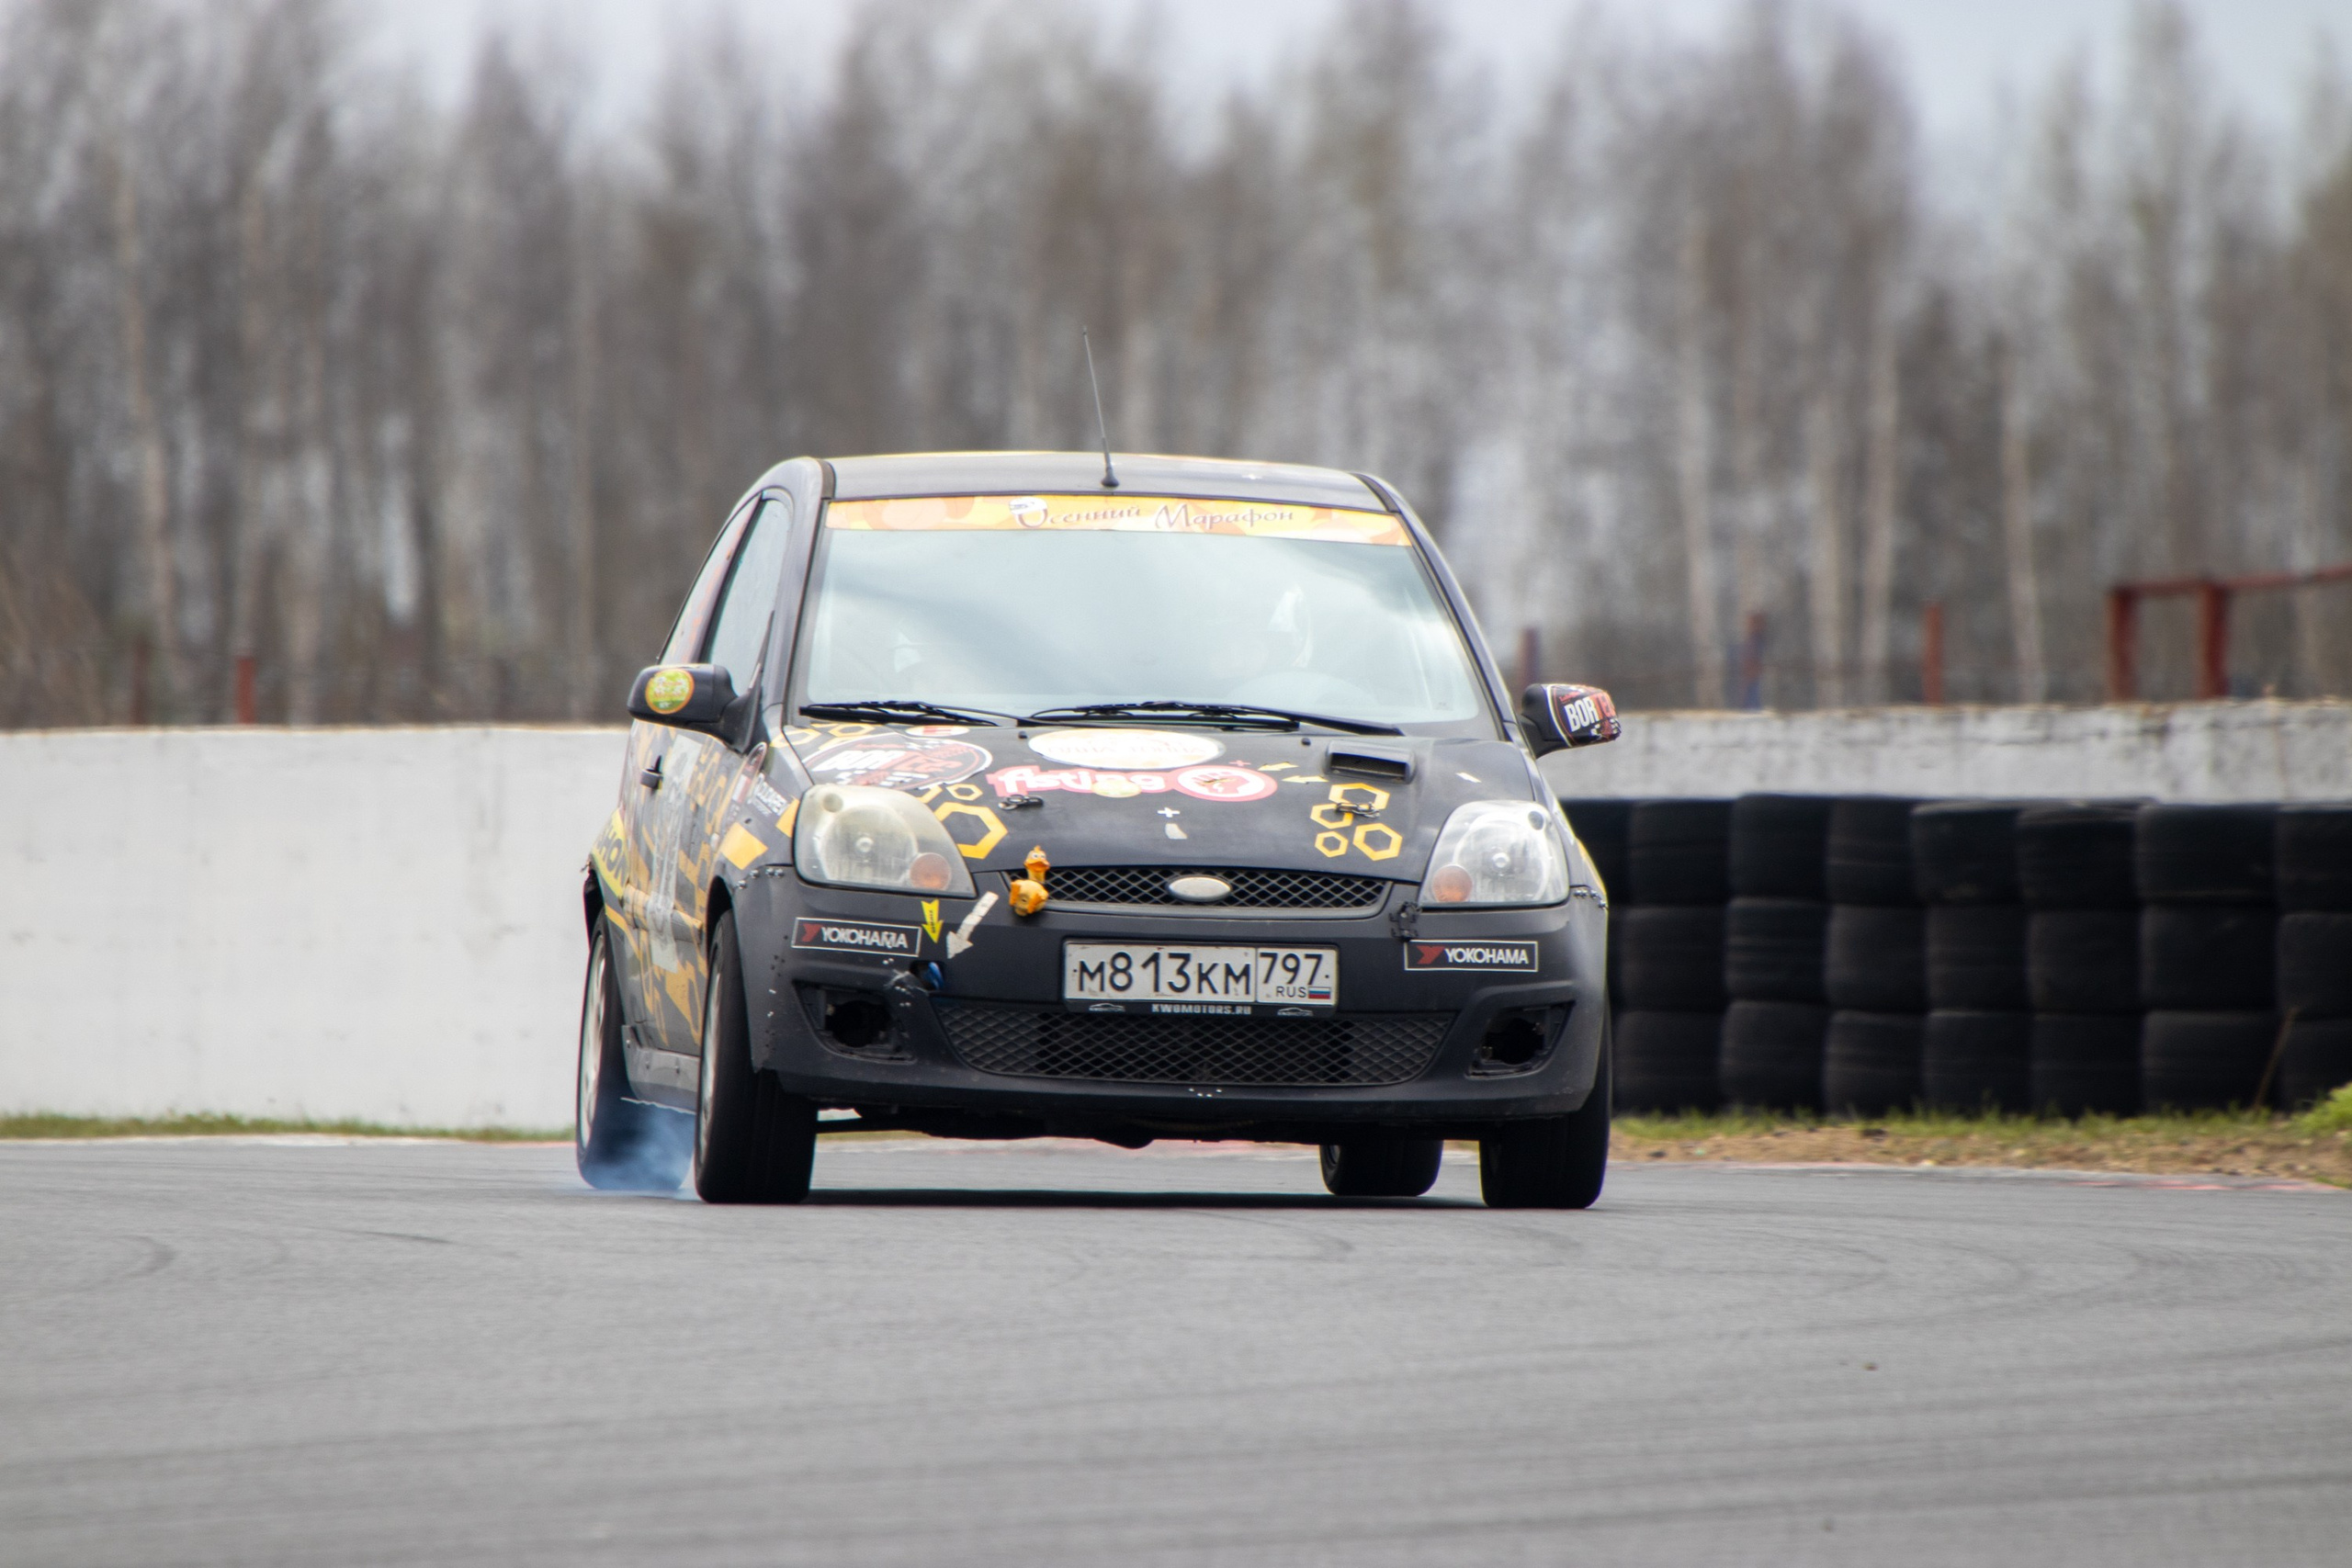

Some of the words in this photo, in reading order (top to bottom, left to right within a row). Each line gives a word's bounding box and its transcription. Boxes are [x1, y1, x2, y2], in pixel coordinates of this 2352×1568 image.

[1016, 503, 1141, 529] Осенний
[1155, 503, 1294, 530] Марафон
[1444, 948, 1529, 964] YOKOHAMA
[1078, 952, 1250, 995] M813KM
[1260, 952, 1323, 986] 797
[1275, 986, 1306, 998] RUS
